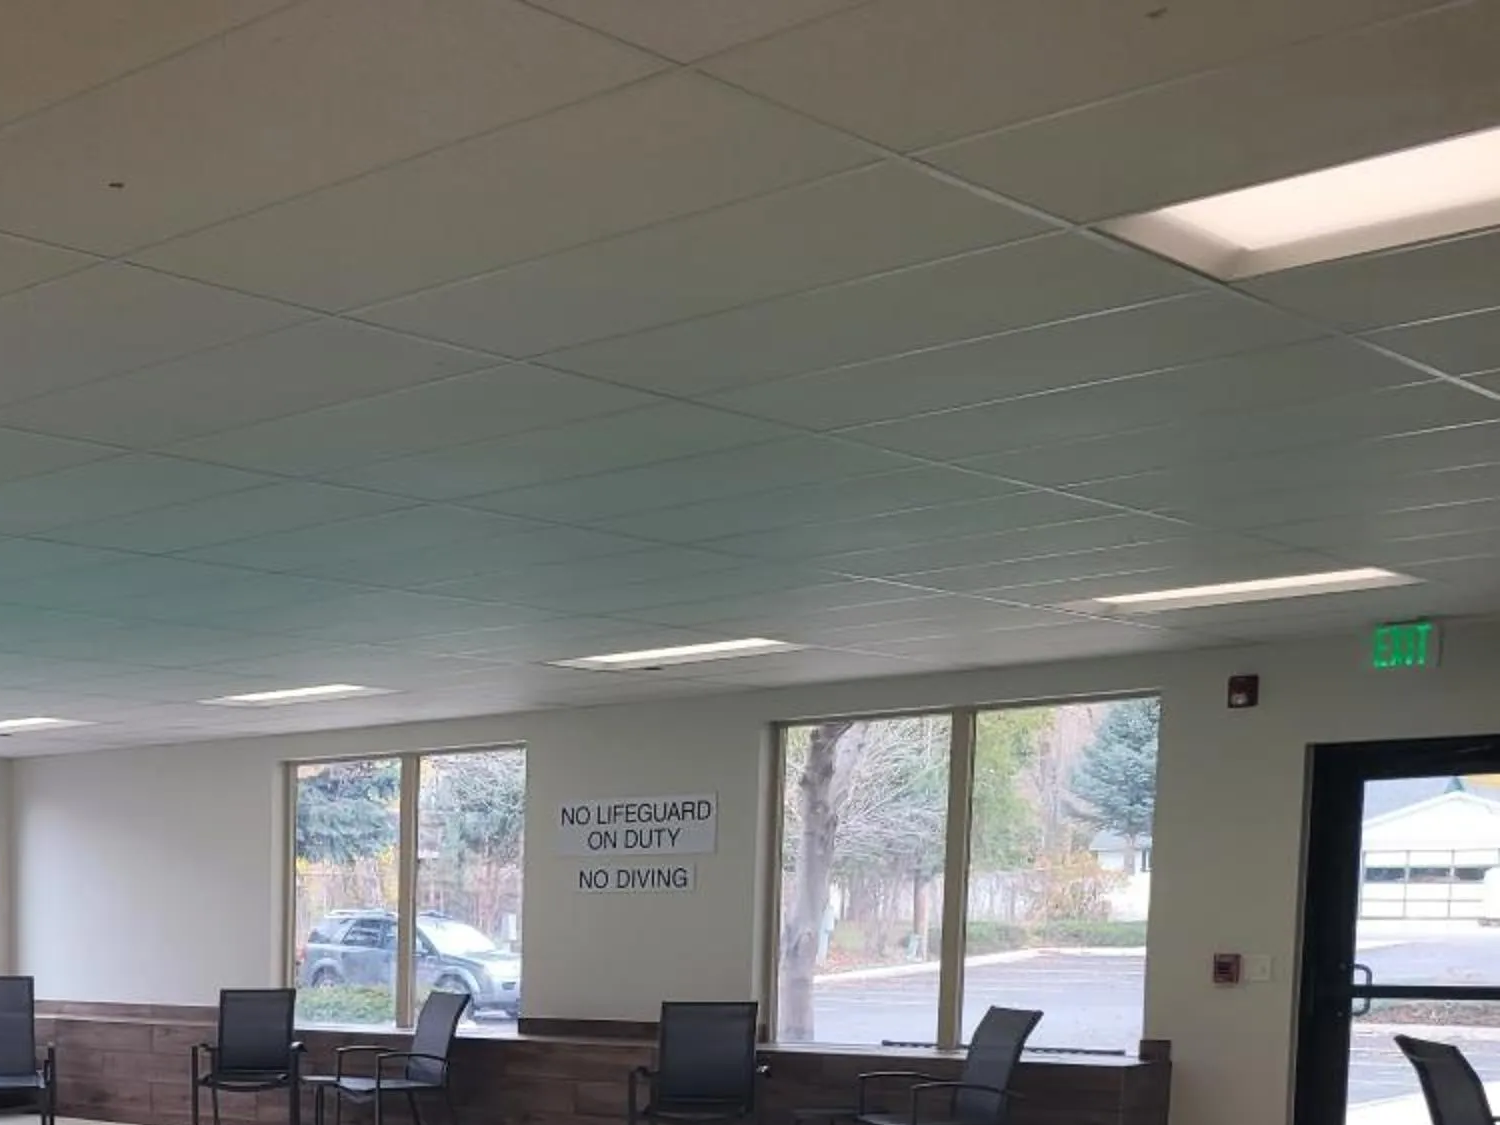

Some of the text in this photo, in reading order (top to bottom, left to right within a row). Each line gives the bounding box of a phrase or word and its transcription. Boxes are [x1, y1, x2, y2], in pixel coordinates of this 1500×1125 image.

[1374, 624, 1432, 668] EXIT
[561, 801, 711, 826] NO LIFEGUARD
[587, 828, 681, 850] ON DUTY
[579, 867, 688, 889] NO DIVING
